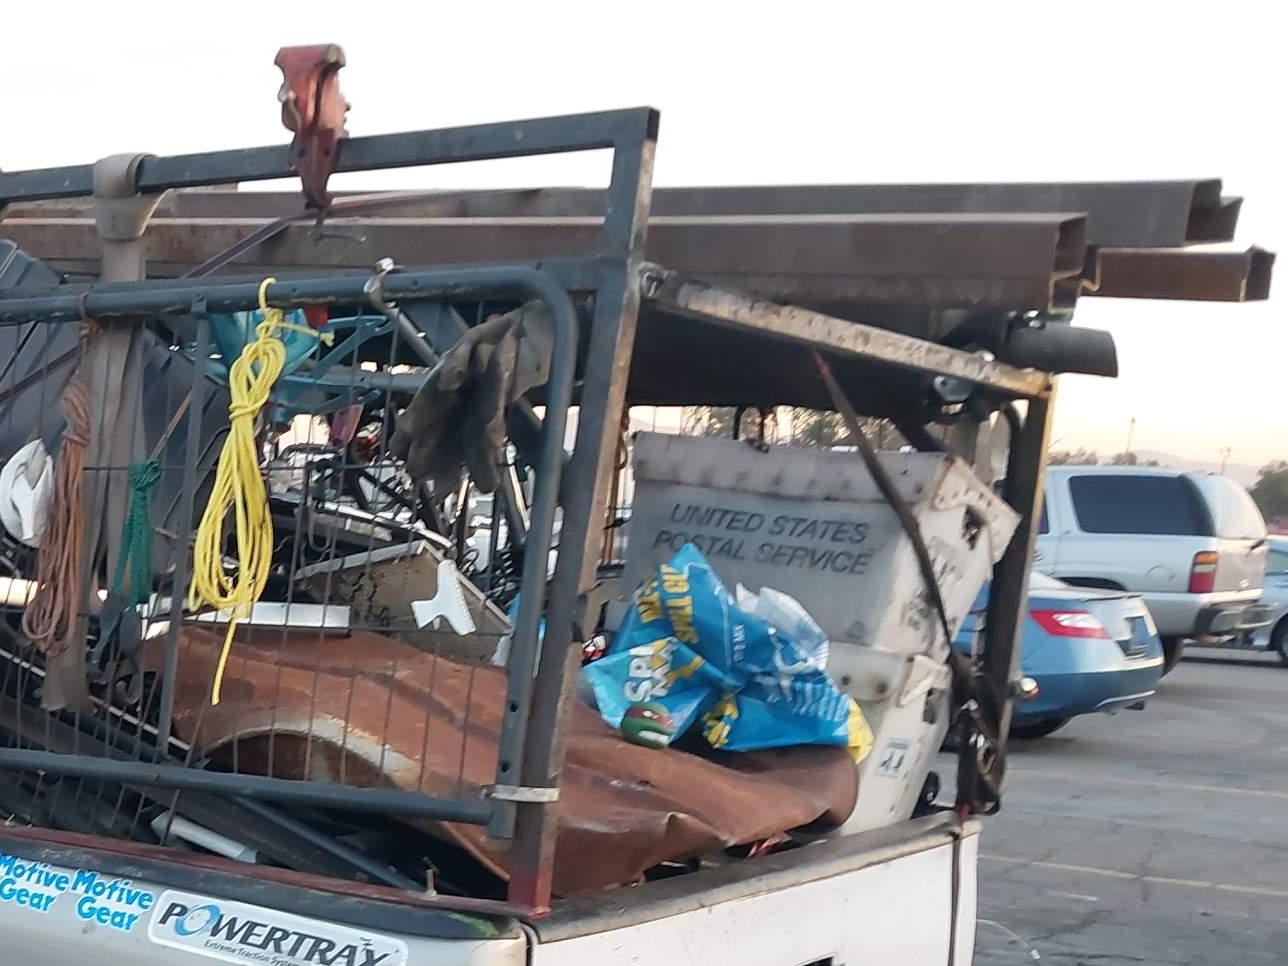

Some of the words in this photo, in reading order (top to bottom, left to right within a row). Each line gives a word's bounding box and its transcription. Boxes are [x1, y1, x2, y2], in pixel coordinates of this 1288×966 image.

[670, 503, 765, 533] UNITED
[768, 515, 871, 544] STATES
[652, 530, 745, 561] POSTAL
[754, 542, 875, 575] SERVICE
[0, 878, 56, 911] Gear
[72, 870, 153, 909] Motive
[77, 896, 139, 930] Gear
